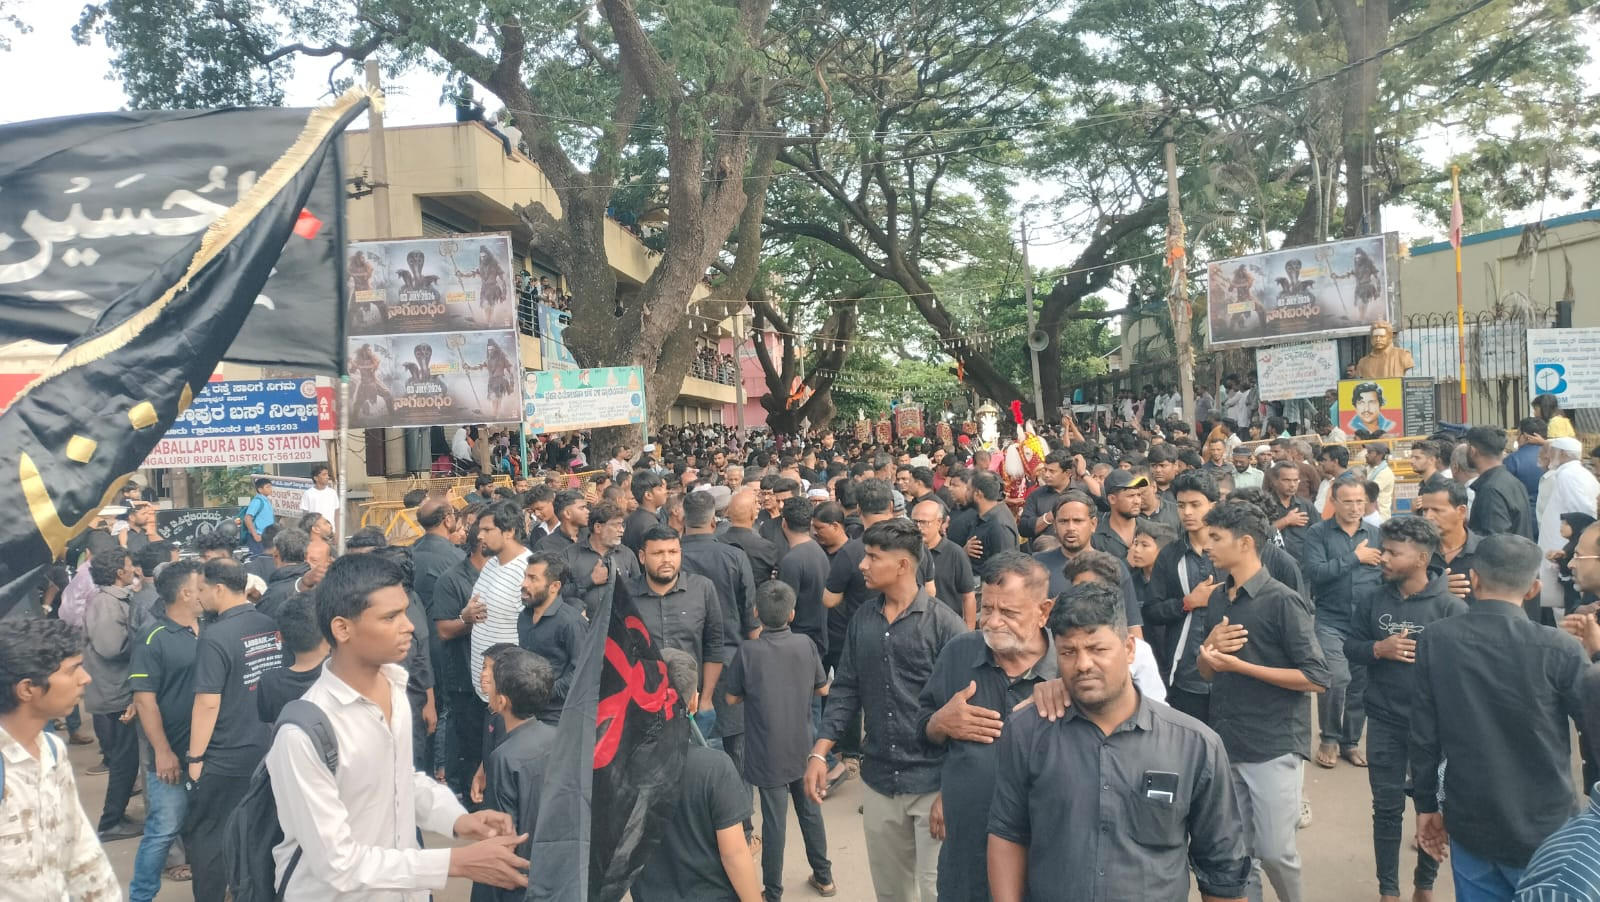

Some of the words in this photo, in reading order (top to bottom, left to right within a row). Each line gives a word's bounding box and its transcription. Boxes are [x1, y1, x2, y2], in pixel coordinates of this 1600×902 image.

[266, 380, 296, 392] ನಿಗಮ
[229, 401, 265, 420] ಬಸ್
[320, 396, 331, 421] ATM
[153, 436, 238, 456] ABALLAPURA
[239, 437, 264, 452] BUS
[268, 435, 320, 450] STATION
[143, 455, 190, 466] NGALURU
[193, 454, 227, 465] RURAL
[229, 451, 312, 463] DISTRICT-561203
